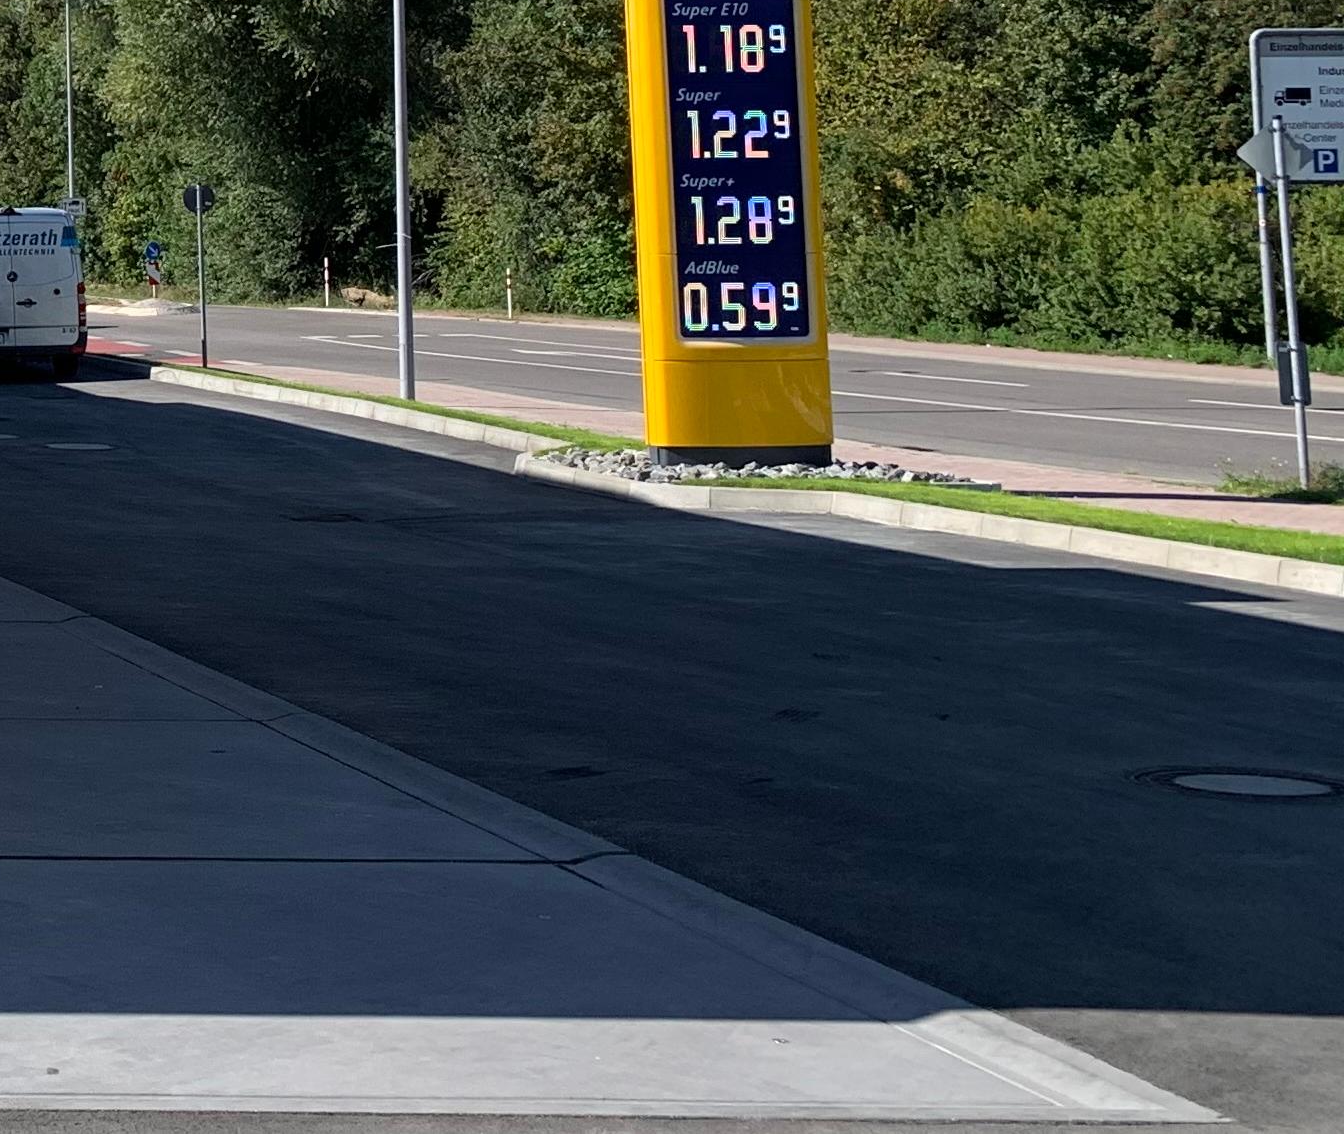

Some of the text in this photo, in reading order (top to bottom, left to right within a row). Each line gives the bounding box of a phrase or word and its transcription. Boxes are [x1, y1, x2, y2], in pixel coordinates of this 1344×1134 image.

[672, 2, 749, 19] Super E10
[676, 87, 721, 105] Super
[1317, 150, 1335, 172] P
[680, 173, 735, 190] Super+
[685, 261, 740, 275] AdBlue
